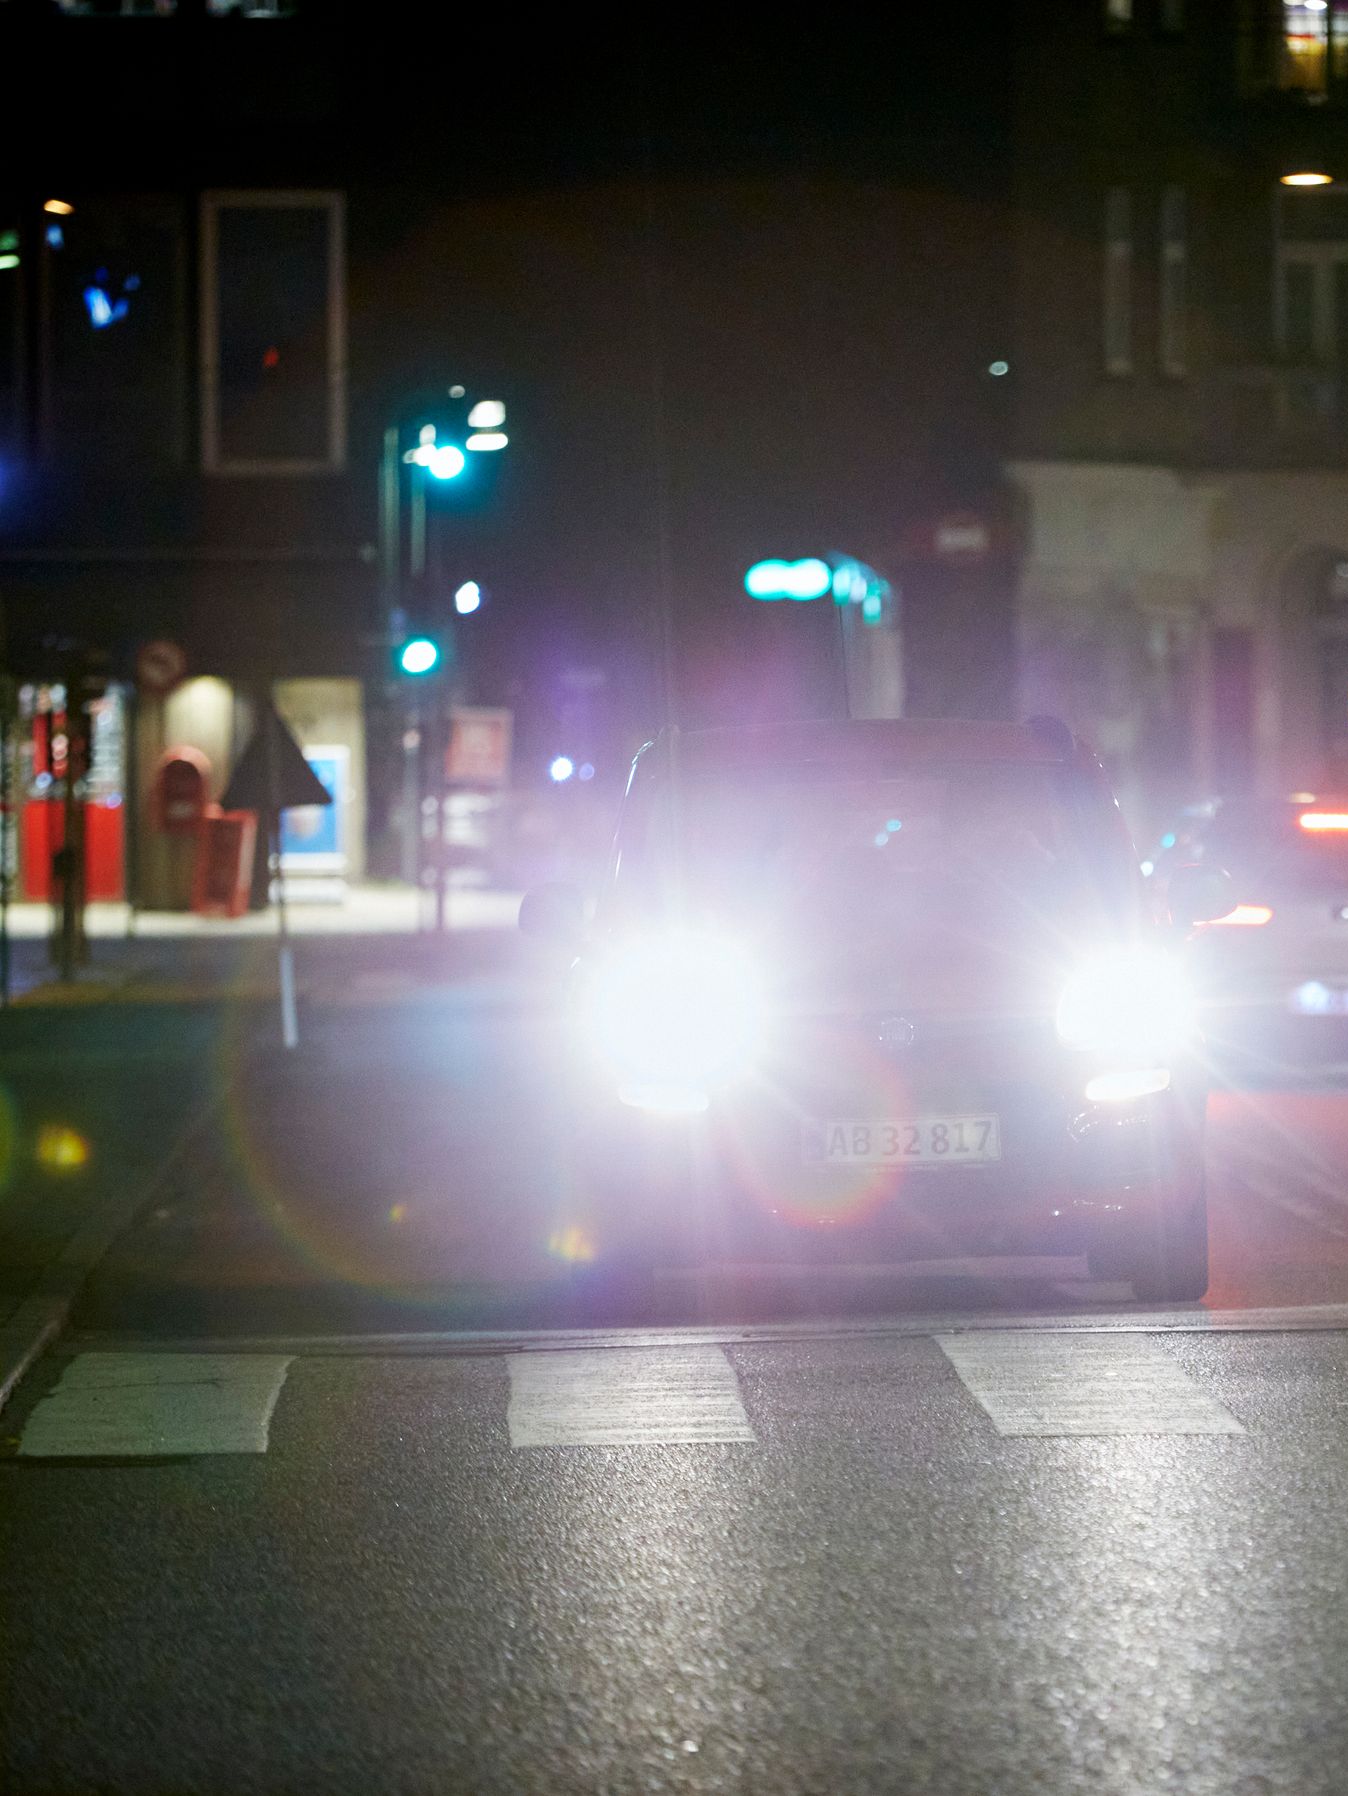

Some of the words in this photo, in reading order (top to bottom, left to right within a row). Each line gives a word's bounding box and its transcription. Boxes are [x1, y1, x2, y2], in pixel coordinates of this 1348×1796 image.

[828, 1125, 871, 1156] AB
[882, 1125, 921, 1156] 32
[930, 1120, 992, 1155] 817
